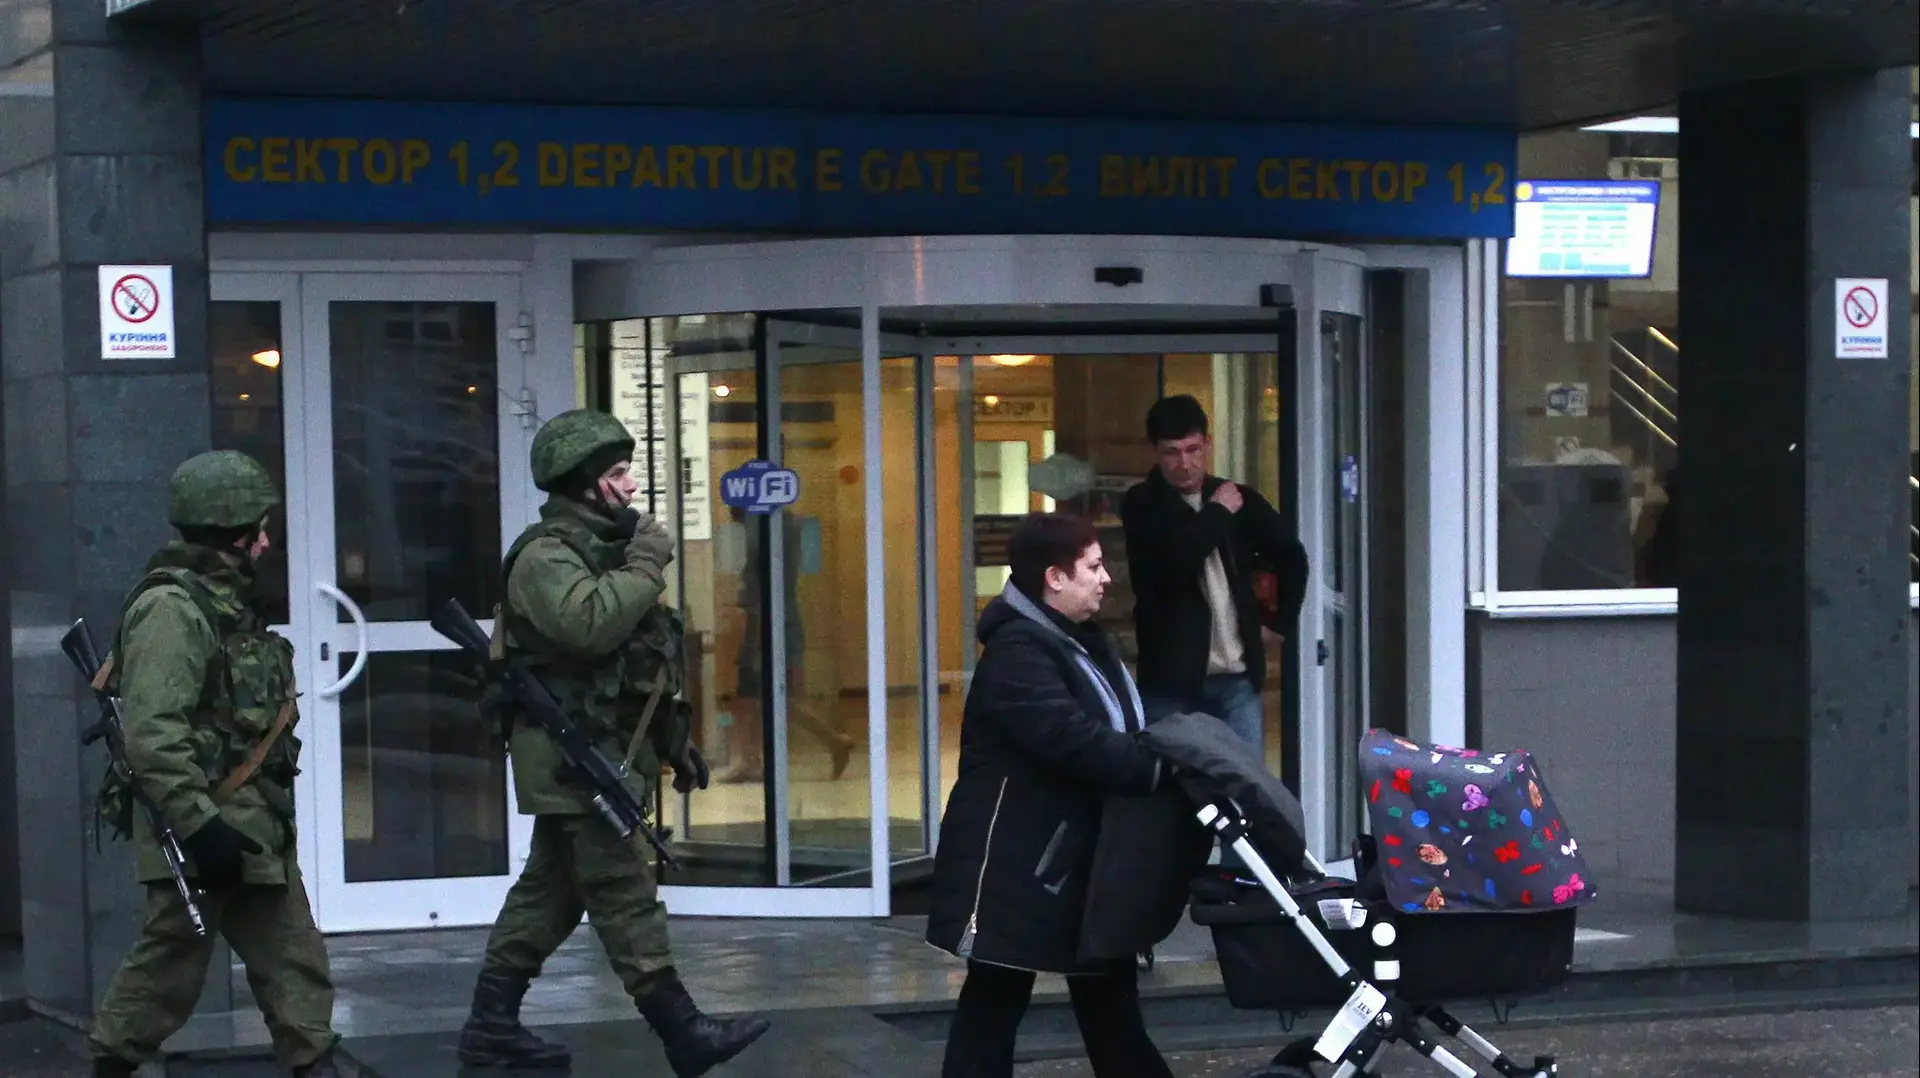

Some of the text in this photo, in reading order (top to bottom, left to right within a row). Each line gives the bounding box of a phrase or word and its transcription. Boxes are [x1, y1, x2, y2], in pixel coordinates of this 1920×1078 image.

[223, 136, 431, 186] СЕКТОР
[447, 140, 520, 196] 1,2
[858, 149, 981, 195] GATE
[1006, 154, 1069, 202] 1,2
[1100, 155, 1237, 198] ВИЛІТ
[1256, 158, 1428, 204] СЕКТОР
[1446, 162, 1506, 213] 1,2
[109, 332, 167, 342] КУРІННЯ
